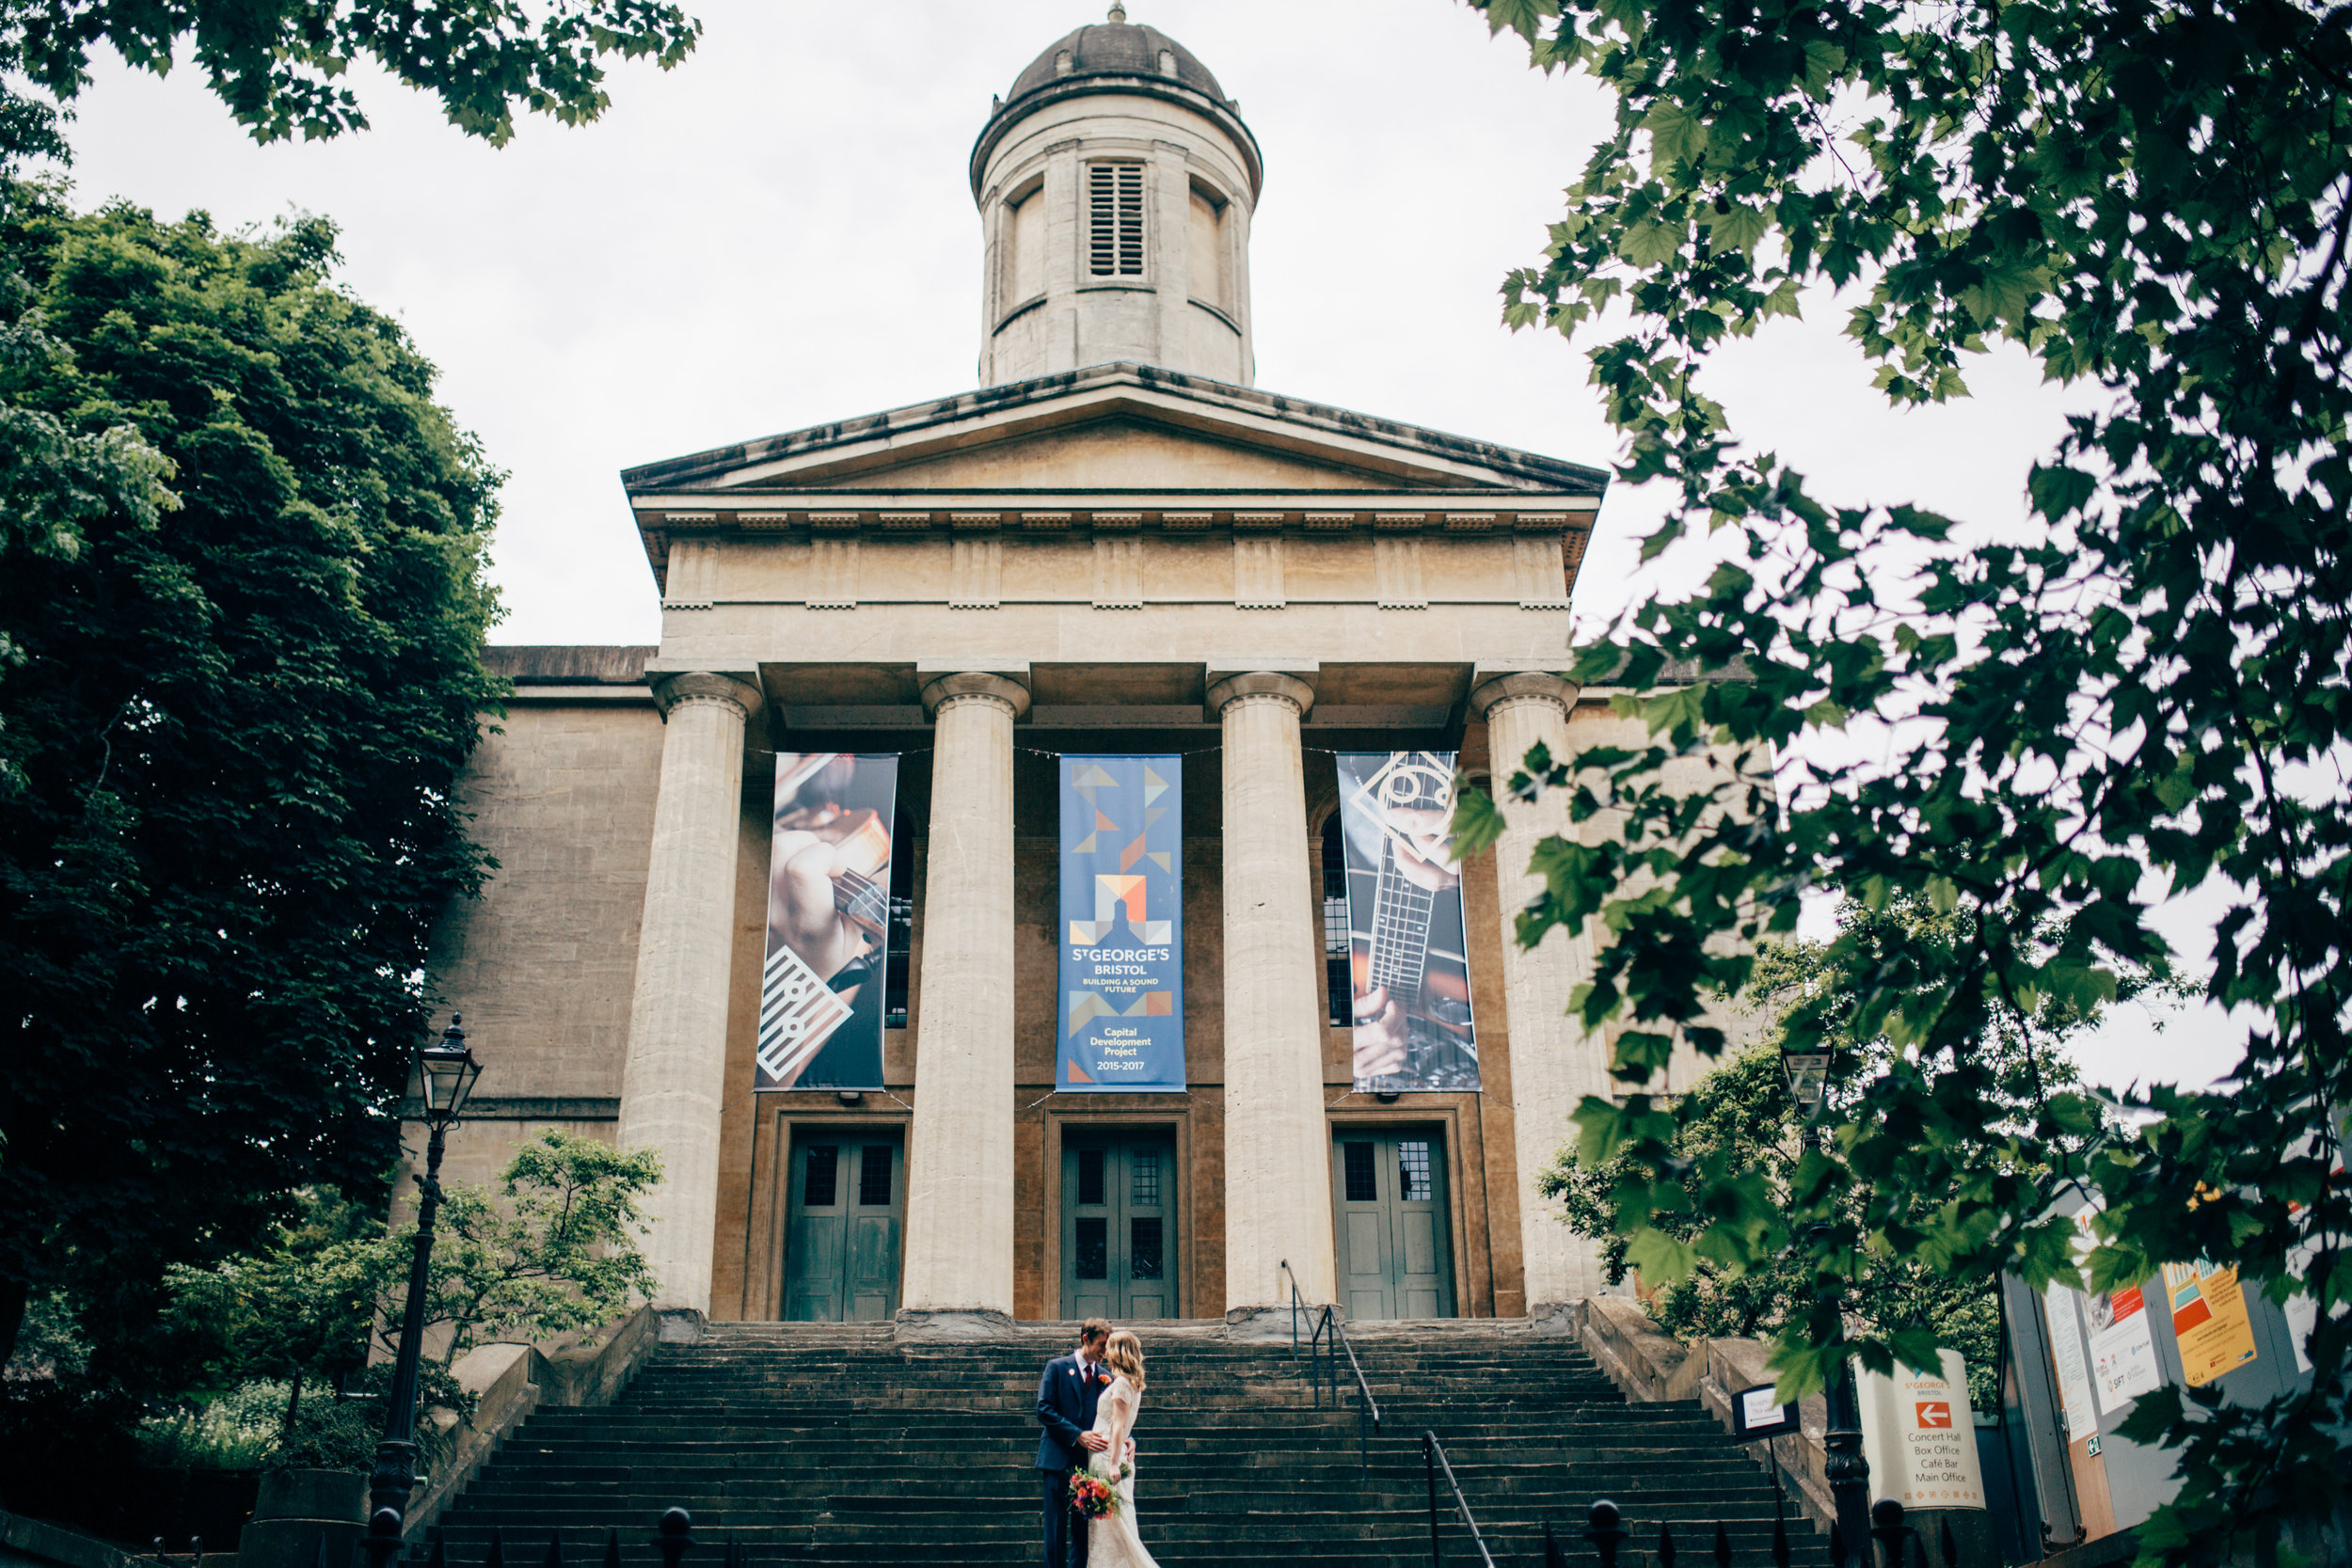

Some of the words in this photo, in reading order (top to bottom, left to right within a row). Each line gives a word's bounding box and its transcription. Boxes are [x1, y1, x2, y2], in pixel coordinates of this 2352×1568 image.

[1094, 965, 1147, 974] BRISTOL
[1104, 1027, 1137, 1037] Capital
[1090, 1037, 1152, 1047] Development
[1104, 1047, 1137, 1057] Project
[1097, 1061, 1145, 1070] 2015-2017
[1908, 1433, 1944, 1442] Concert
[1946, 1432, 1962, 1442] Hall
[1915, 1446, 1931, 1455] Box
[1933, 1445, 1960, 1455] Office
[1920, 1458, 1943, 1468] Café
[1945, 1458, 1958, 1468] Bar
[1915, 1473, 1939, 1482] Main
[1941, 1472, 1966, 1482] Office
